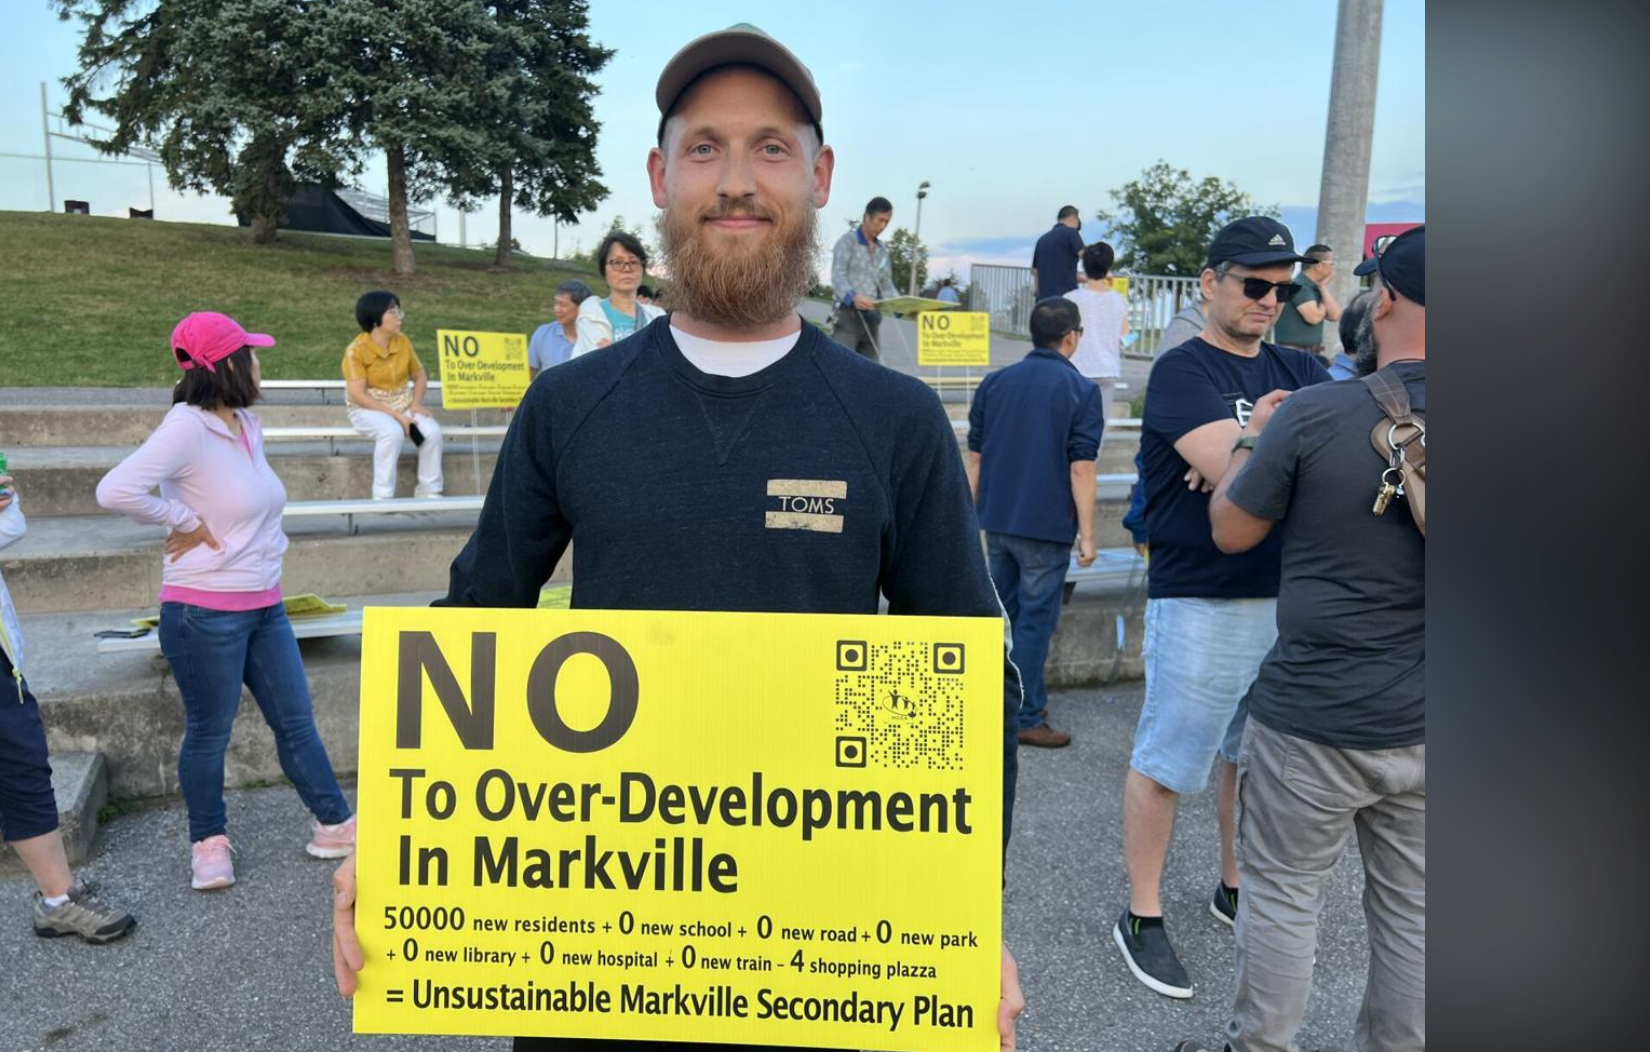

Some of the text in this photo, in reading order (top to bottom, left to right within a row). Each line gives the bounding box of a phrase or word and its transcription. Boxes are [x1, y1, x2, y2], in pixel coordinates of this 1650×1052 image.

[922, 314, 950, 330] NO
[443, 335, 479, 357] NO
[445, 360, 524, 372] To Over-Development
[447, 372, 495, 381] In Markville
[778, 496, 834, 514] TOMS
[395, 630, 640, 754] NO
[388, 768, 973, 842] To Over-Development
[399, 834, 738, 894] In Markville
[384, 905, 978, 950] 50000 new residents + 0 new school + 0 new road + 0 new park
[386, 949, 396, 961] +
[402, 937, 419, 962] 0
[425, 950, 458, 962] new
[463, 946, 517, 967] library
[521, 952, 531, 964] +
[539, 940, 555, 965] 0
[562, 953, 593, 966] new
[597, 949, 658, 971] hospital
[665, 956, 675, 968] +
[681, 944, 697, 969] 0
[701, 957, 732, 970] new
[736, 955, 772, 972] train
[789, 948, 805, 973] 4
[809, 957, 881, 980] shopping
[886, 960, 937, 980] plazza
[386, 978, 974, 1032] = Unsustainable Markville Secondary Plan
